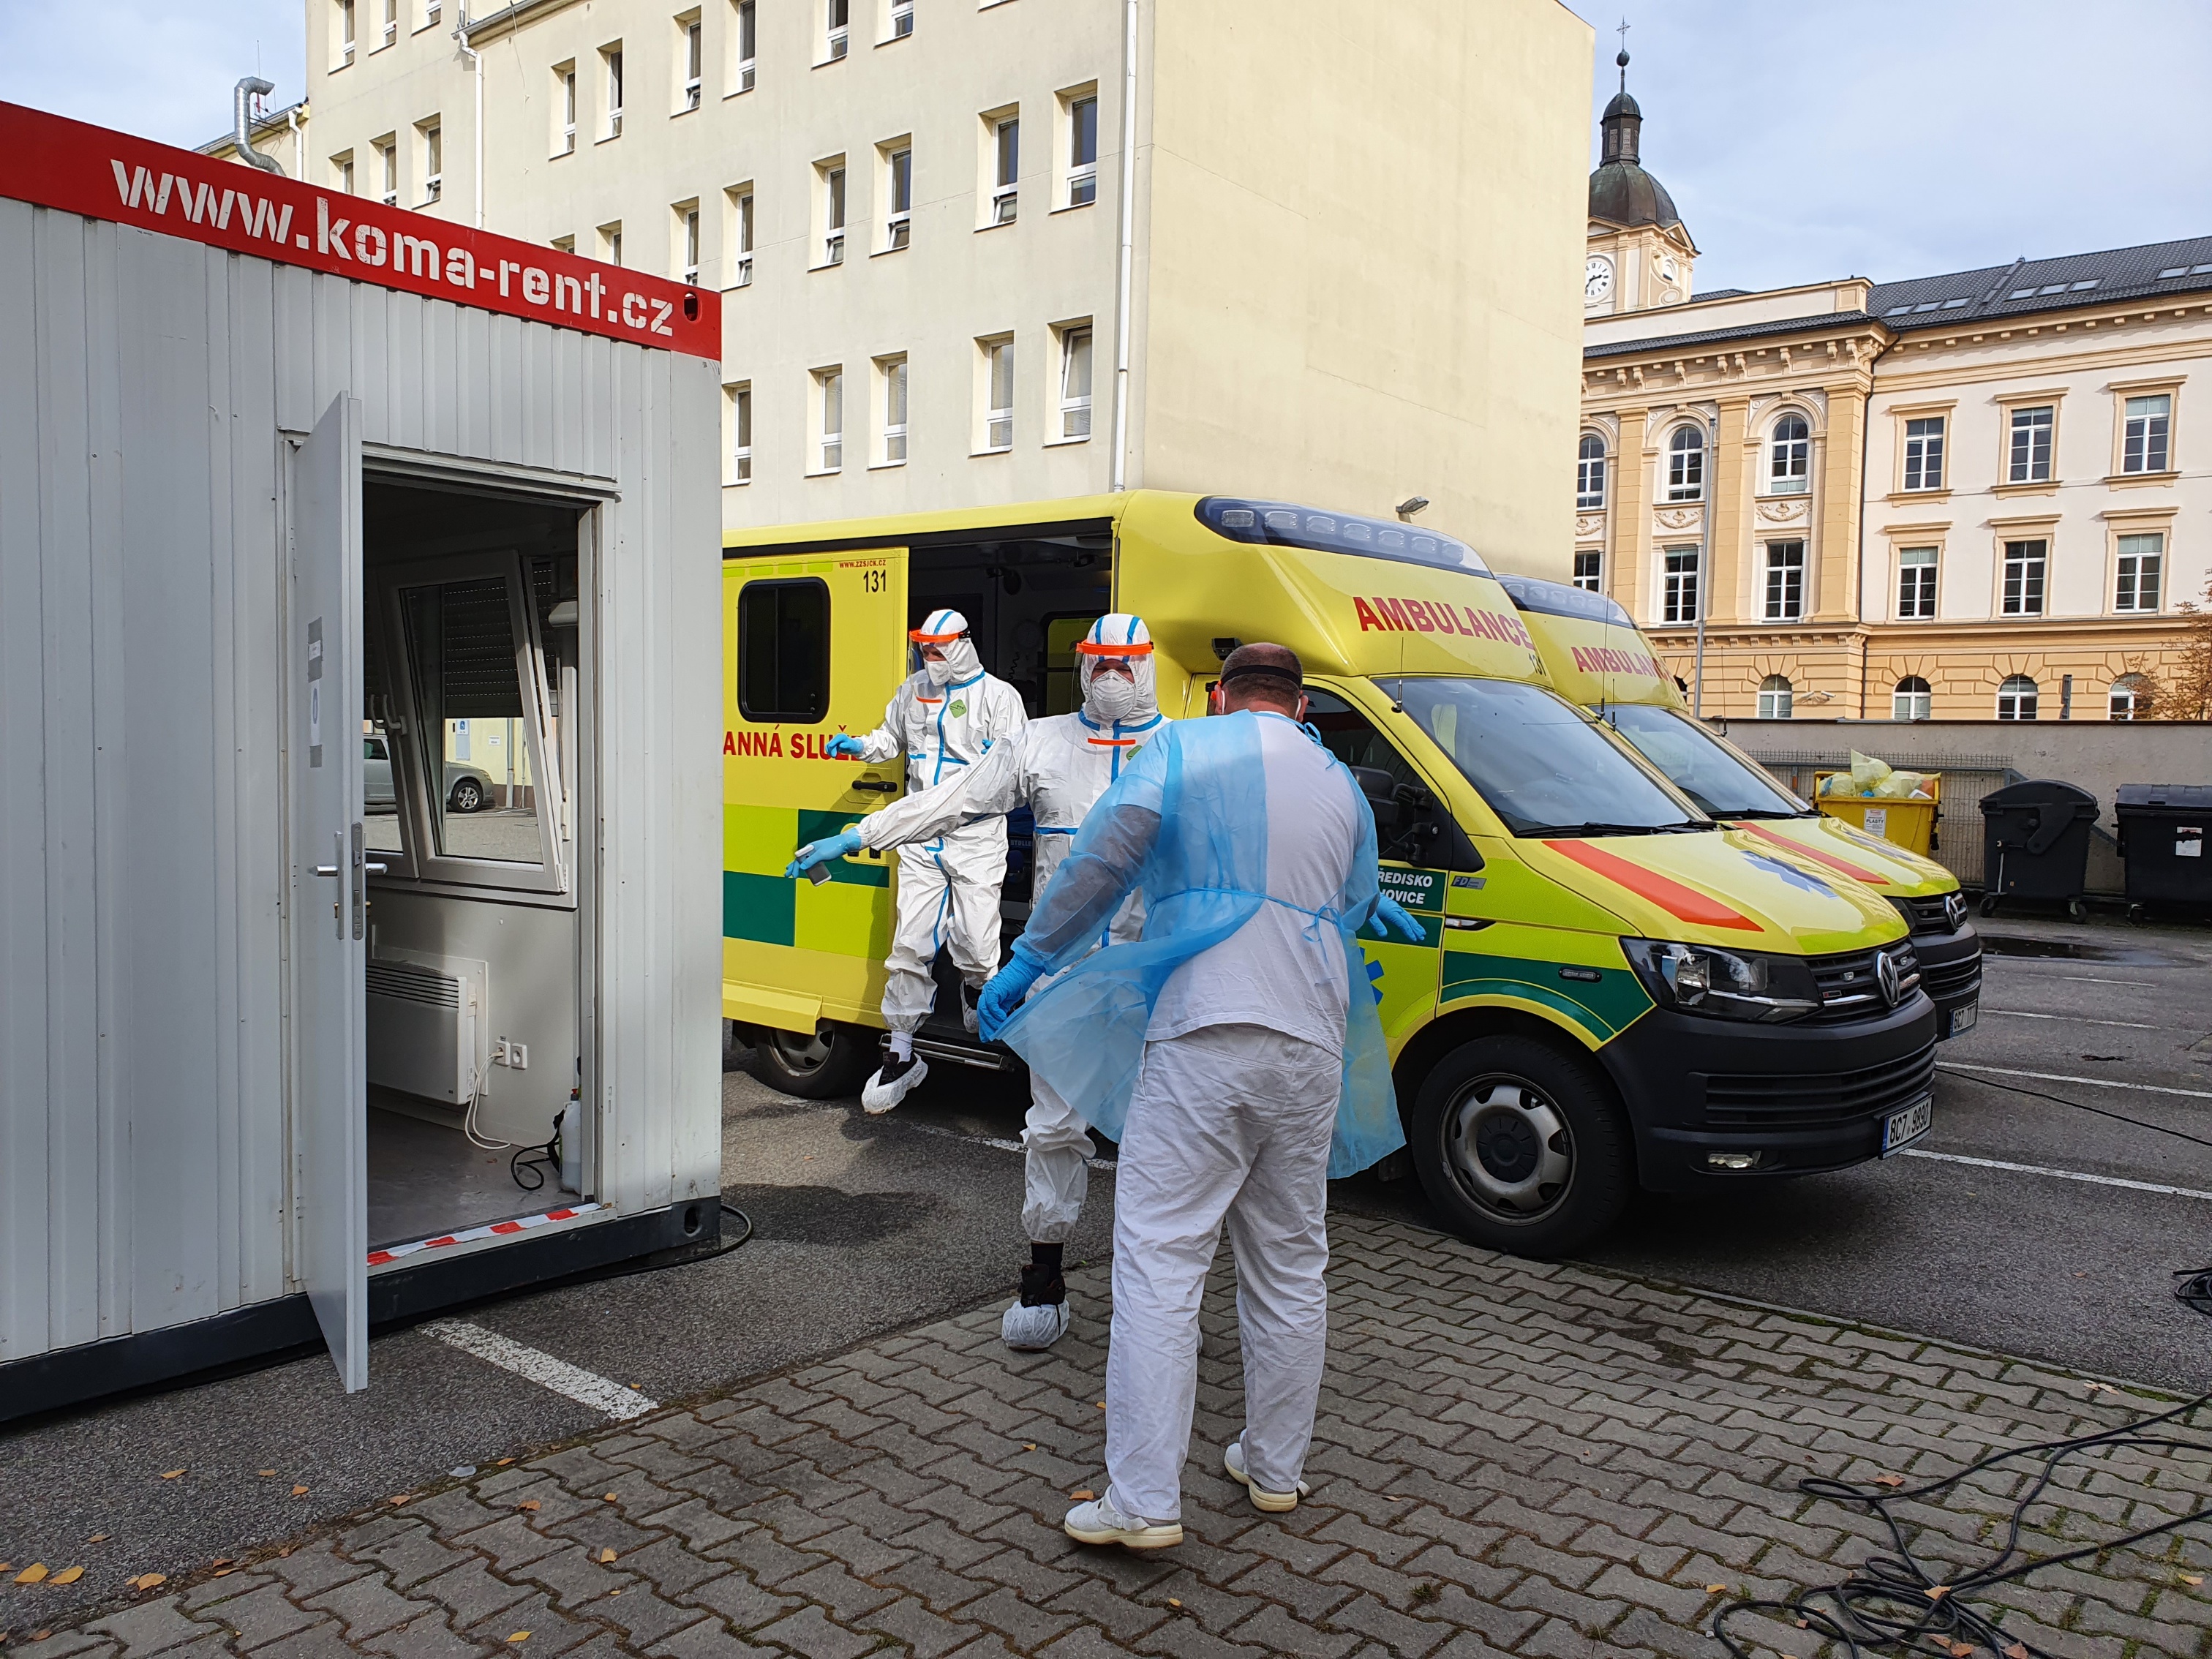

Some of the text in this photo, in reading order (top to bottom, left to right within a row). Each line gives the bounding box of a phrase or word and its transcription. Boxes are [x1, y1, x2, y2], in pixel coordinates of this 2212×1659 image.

[110, 159, 673, 336] www.koma-rent.cz
[863, 569, 886, 592] 131
[1353, 596, 1535, 651] AMBULANCE
[1528, 652, 1546, 677] 131
[723, 724, 783, 758] ANNÁ
[1453, 876, 1469, 886] FD
[1890, 1114, 1908, 1143] 8C7
